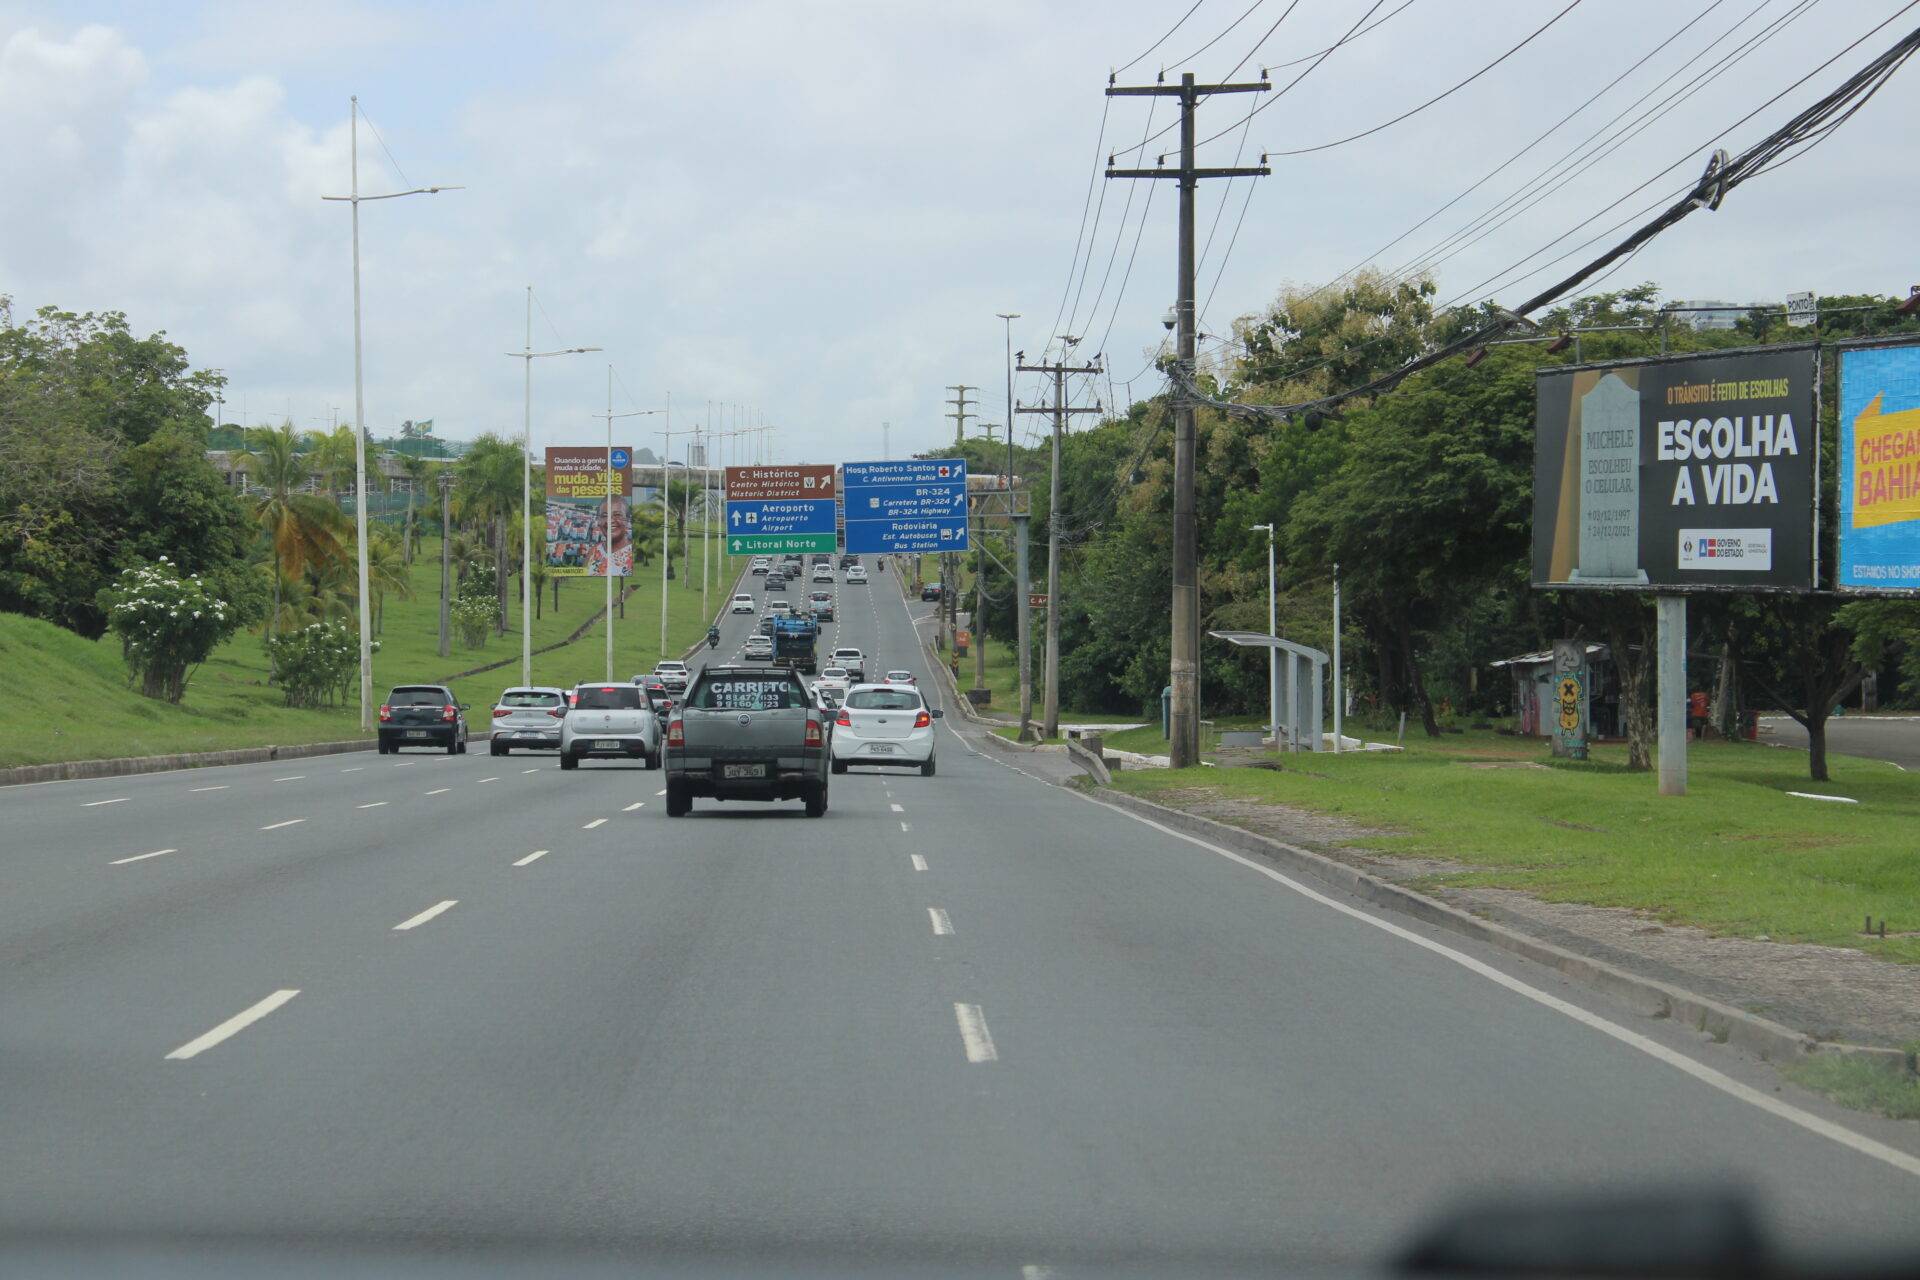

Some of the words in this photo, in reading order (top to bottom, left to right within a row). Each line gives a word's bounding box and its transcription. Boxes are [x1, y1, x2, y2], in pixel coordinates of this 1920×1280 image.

[1667, 387, 1673, 405] O
[1674, 381, 1710, 404] TRÂNSITO
[1710, 379, 1716, 402] É
[1717, 382, 1738, 401] FEITO
[1738, 381, 1749, 400] DE
[1750, 378, 1789, 399] ESCOLHAS
[1586, 429, 1634, 450] MICHELE
[1657, 413, 1799, 461] ESCOLHA
[554, 457, 581, 465] Quando
[587, 457, 606, 466] gente
[1588, 458, 1632, 475] ESCOLHEU
[740, 470, 750, 479] C.
[753, 468, 800, 479] Histórico
[869, 465, 904, 473] Roberto
[907, 464, 936, 472] Santos
[554, 472, 588, 485] muda
[1671, 465, 1696, 506] A
[1701, 462, 1779, 505] VIDA
[556, 485, 570, 494] das
[916, 488, 951, 496] BR-324
[1585, 479, 1592, 494] O
[920, 498, 950, 506] BR-324
[762, 504, 815, 515] Aeroporto
[920, 507, 951, 518] Highway
[761, 515, 808, 523] Aeropuerto
[900, 532, 938, 540] Autobuses
[746, 540, 782, 549] Litoral
[786, 540, 817, 548] Norte
[911, 541, 939, 549] Station
[1717, 538, 1742, 547] GOVERNO
[1716, 549, 1725, 558] DO
[1725, 549, 1744, 558] ESTADO
[1853, 565, 1887, 579] ESTAMOS
[1888, 564, 1900, 579] NO
[710, 681, 791, 694] CARRETO
